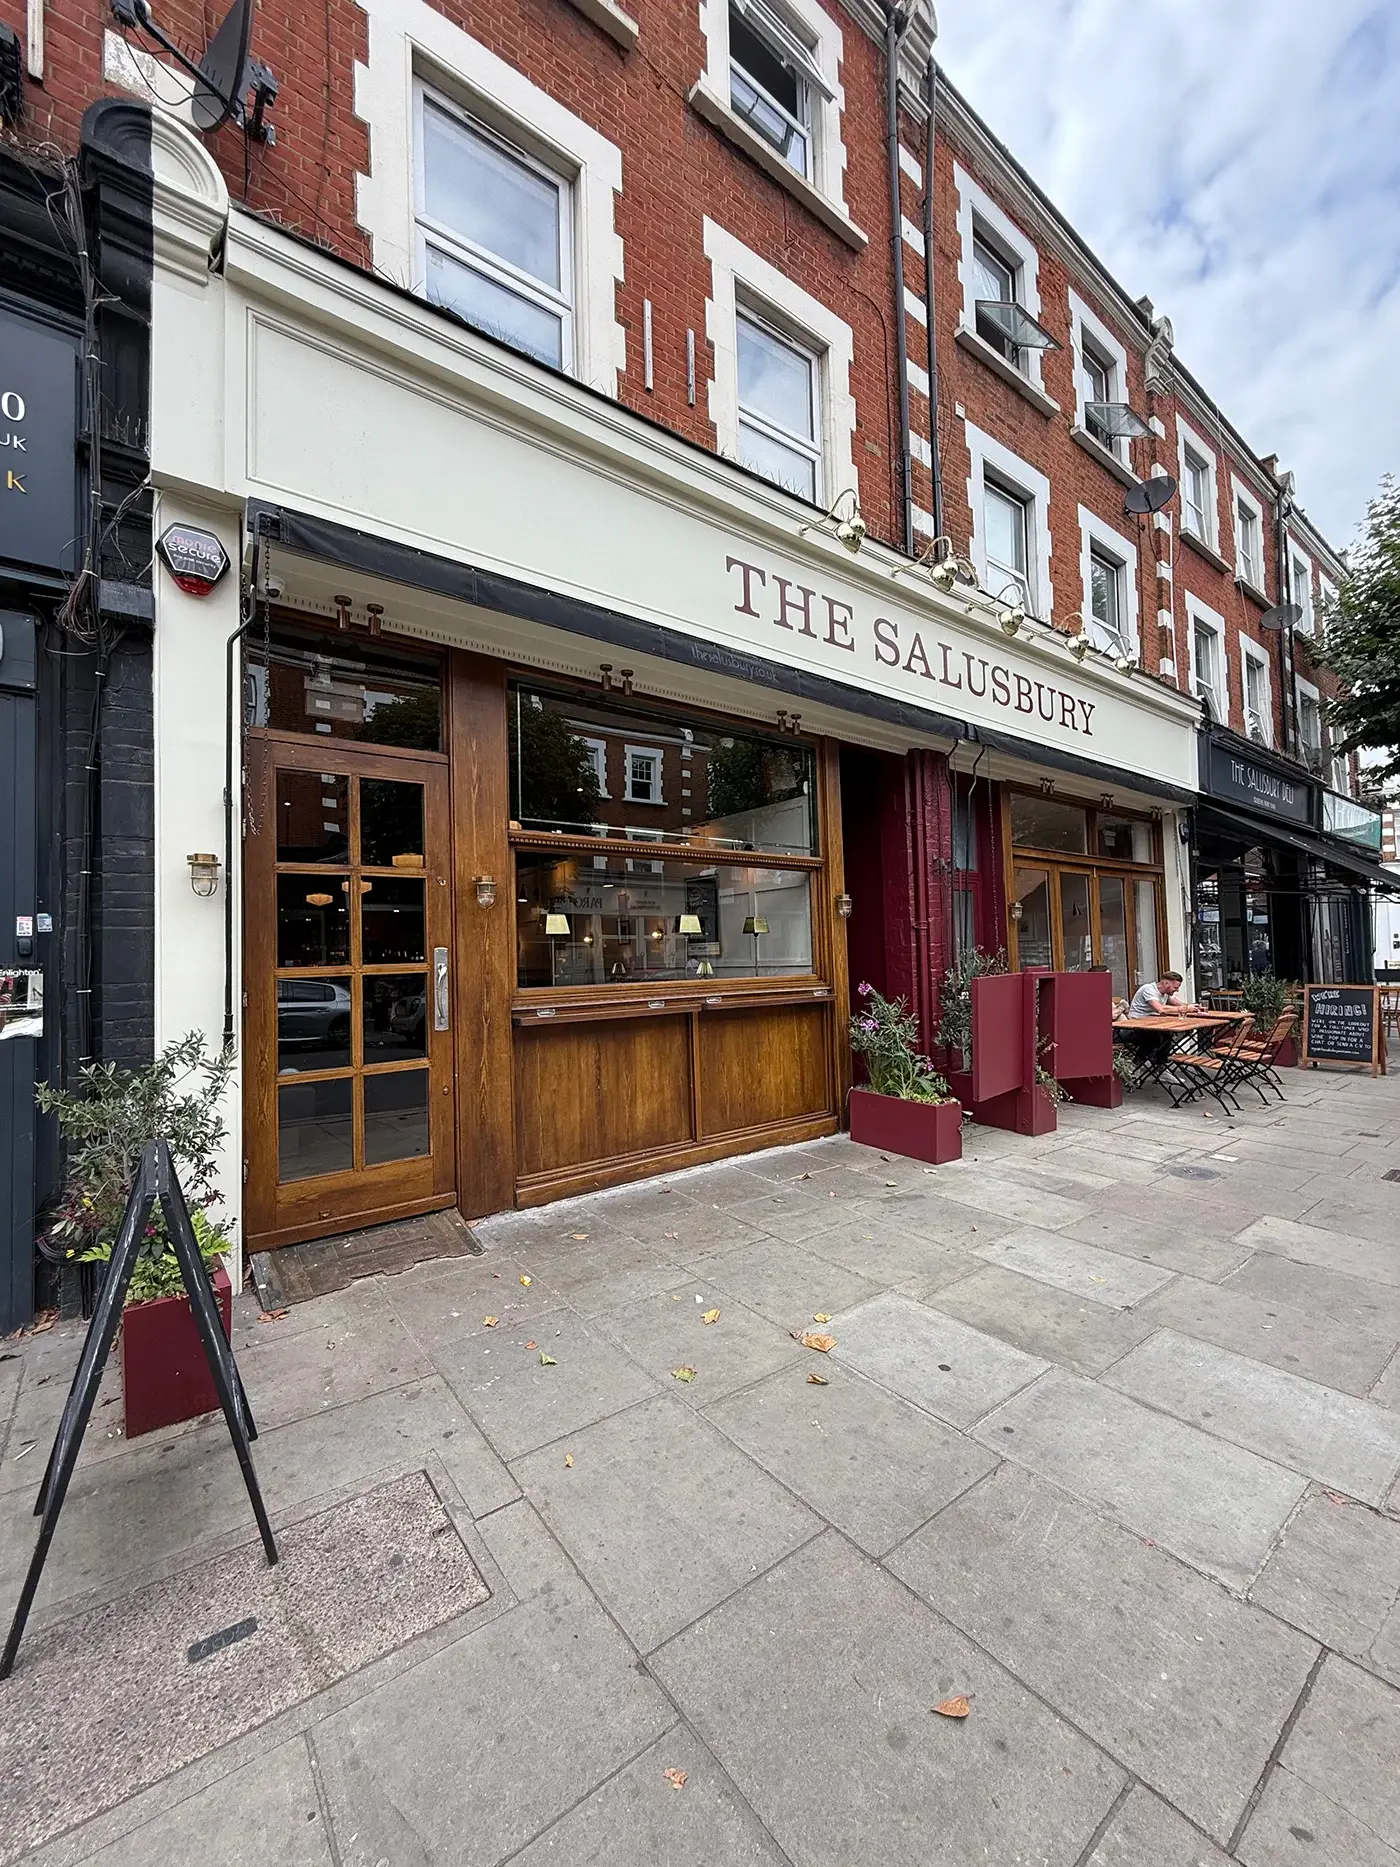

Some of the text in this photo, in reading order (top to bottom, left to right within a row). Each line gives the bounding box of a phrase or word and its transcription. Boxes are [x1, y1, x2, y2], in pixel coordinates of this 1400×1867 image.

[8, 470, 27, 494] K
[168, 542, 221, 563] secure
[725, 555, 1096, 736] THE SALUSBURY
[1231, 760, 1245, 786] THE
[1247, 767, 1280, 799] SALUSBURY
[1315, 1003, 1367, 1016] HIRING!
